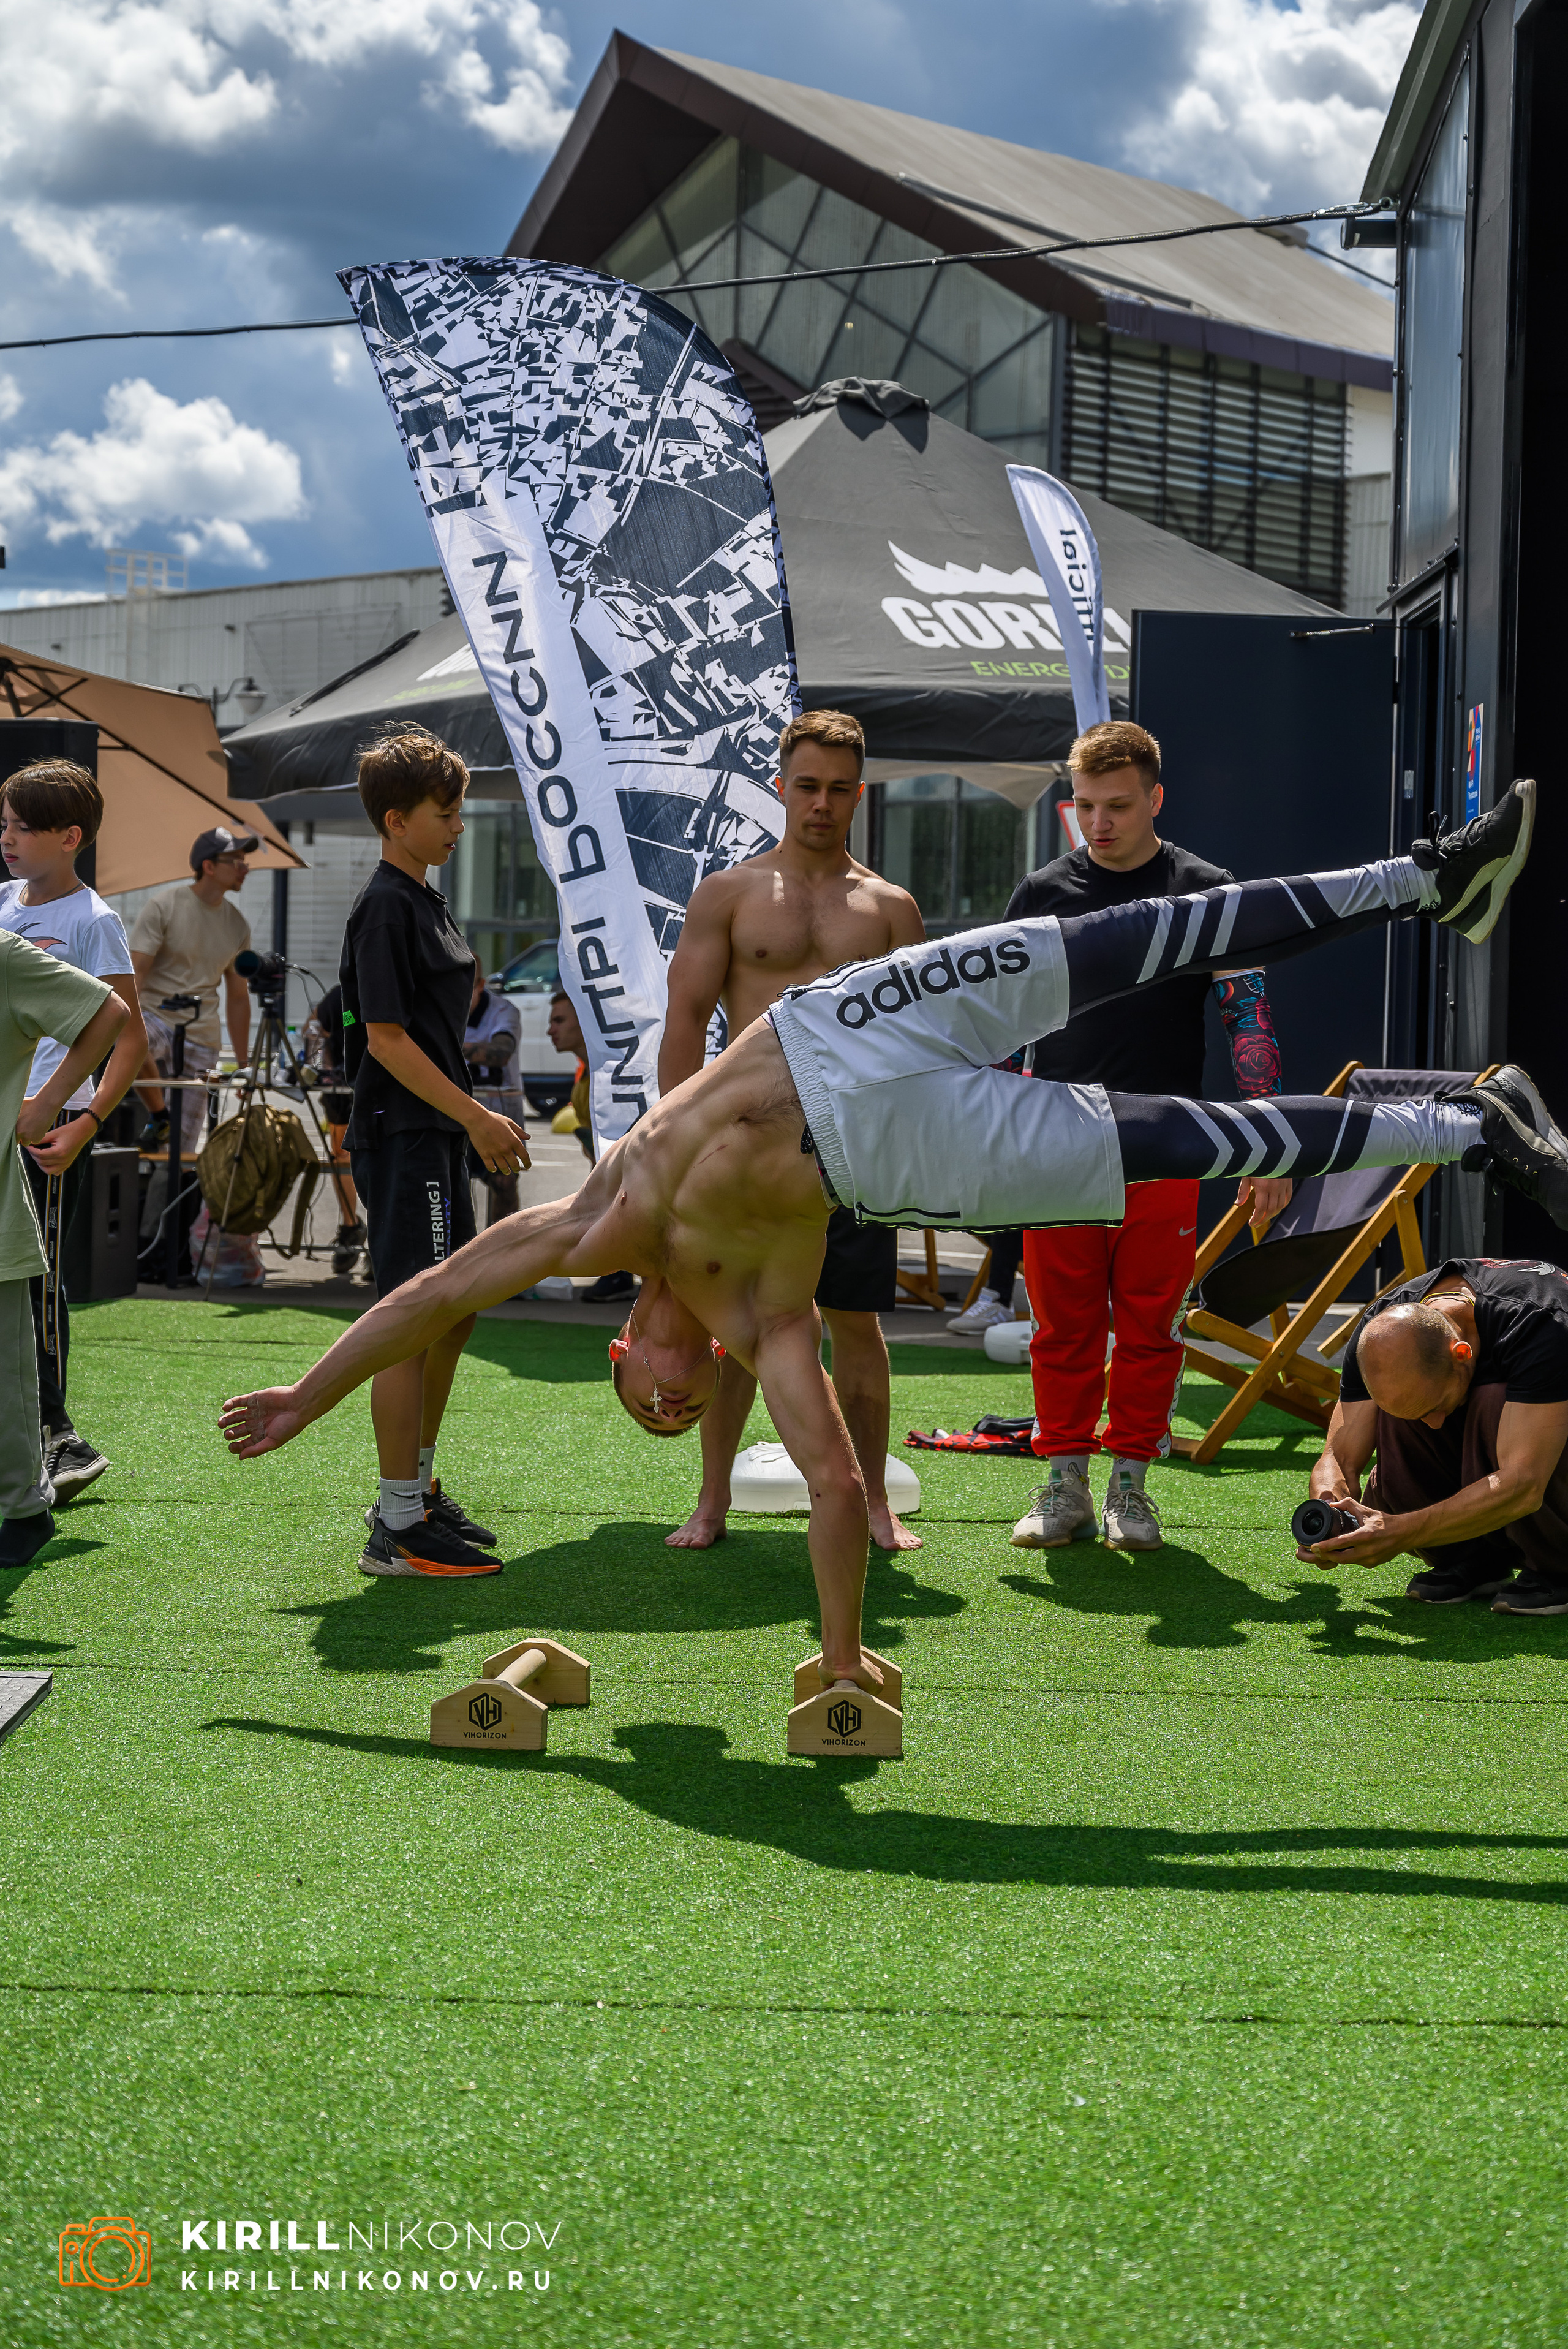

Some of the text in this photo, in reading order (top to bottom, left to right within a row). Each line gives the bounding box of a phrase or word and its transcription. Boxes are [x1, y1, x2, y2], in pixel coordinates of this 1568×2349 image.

[970, 660, 1071, 678] ENERG
[836, 940, 1031, 1029] adidas
[428, 1190, 445, 1260] LTERING
